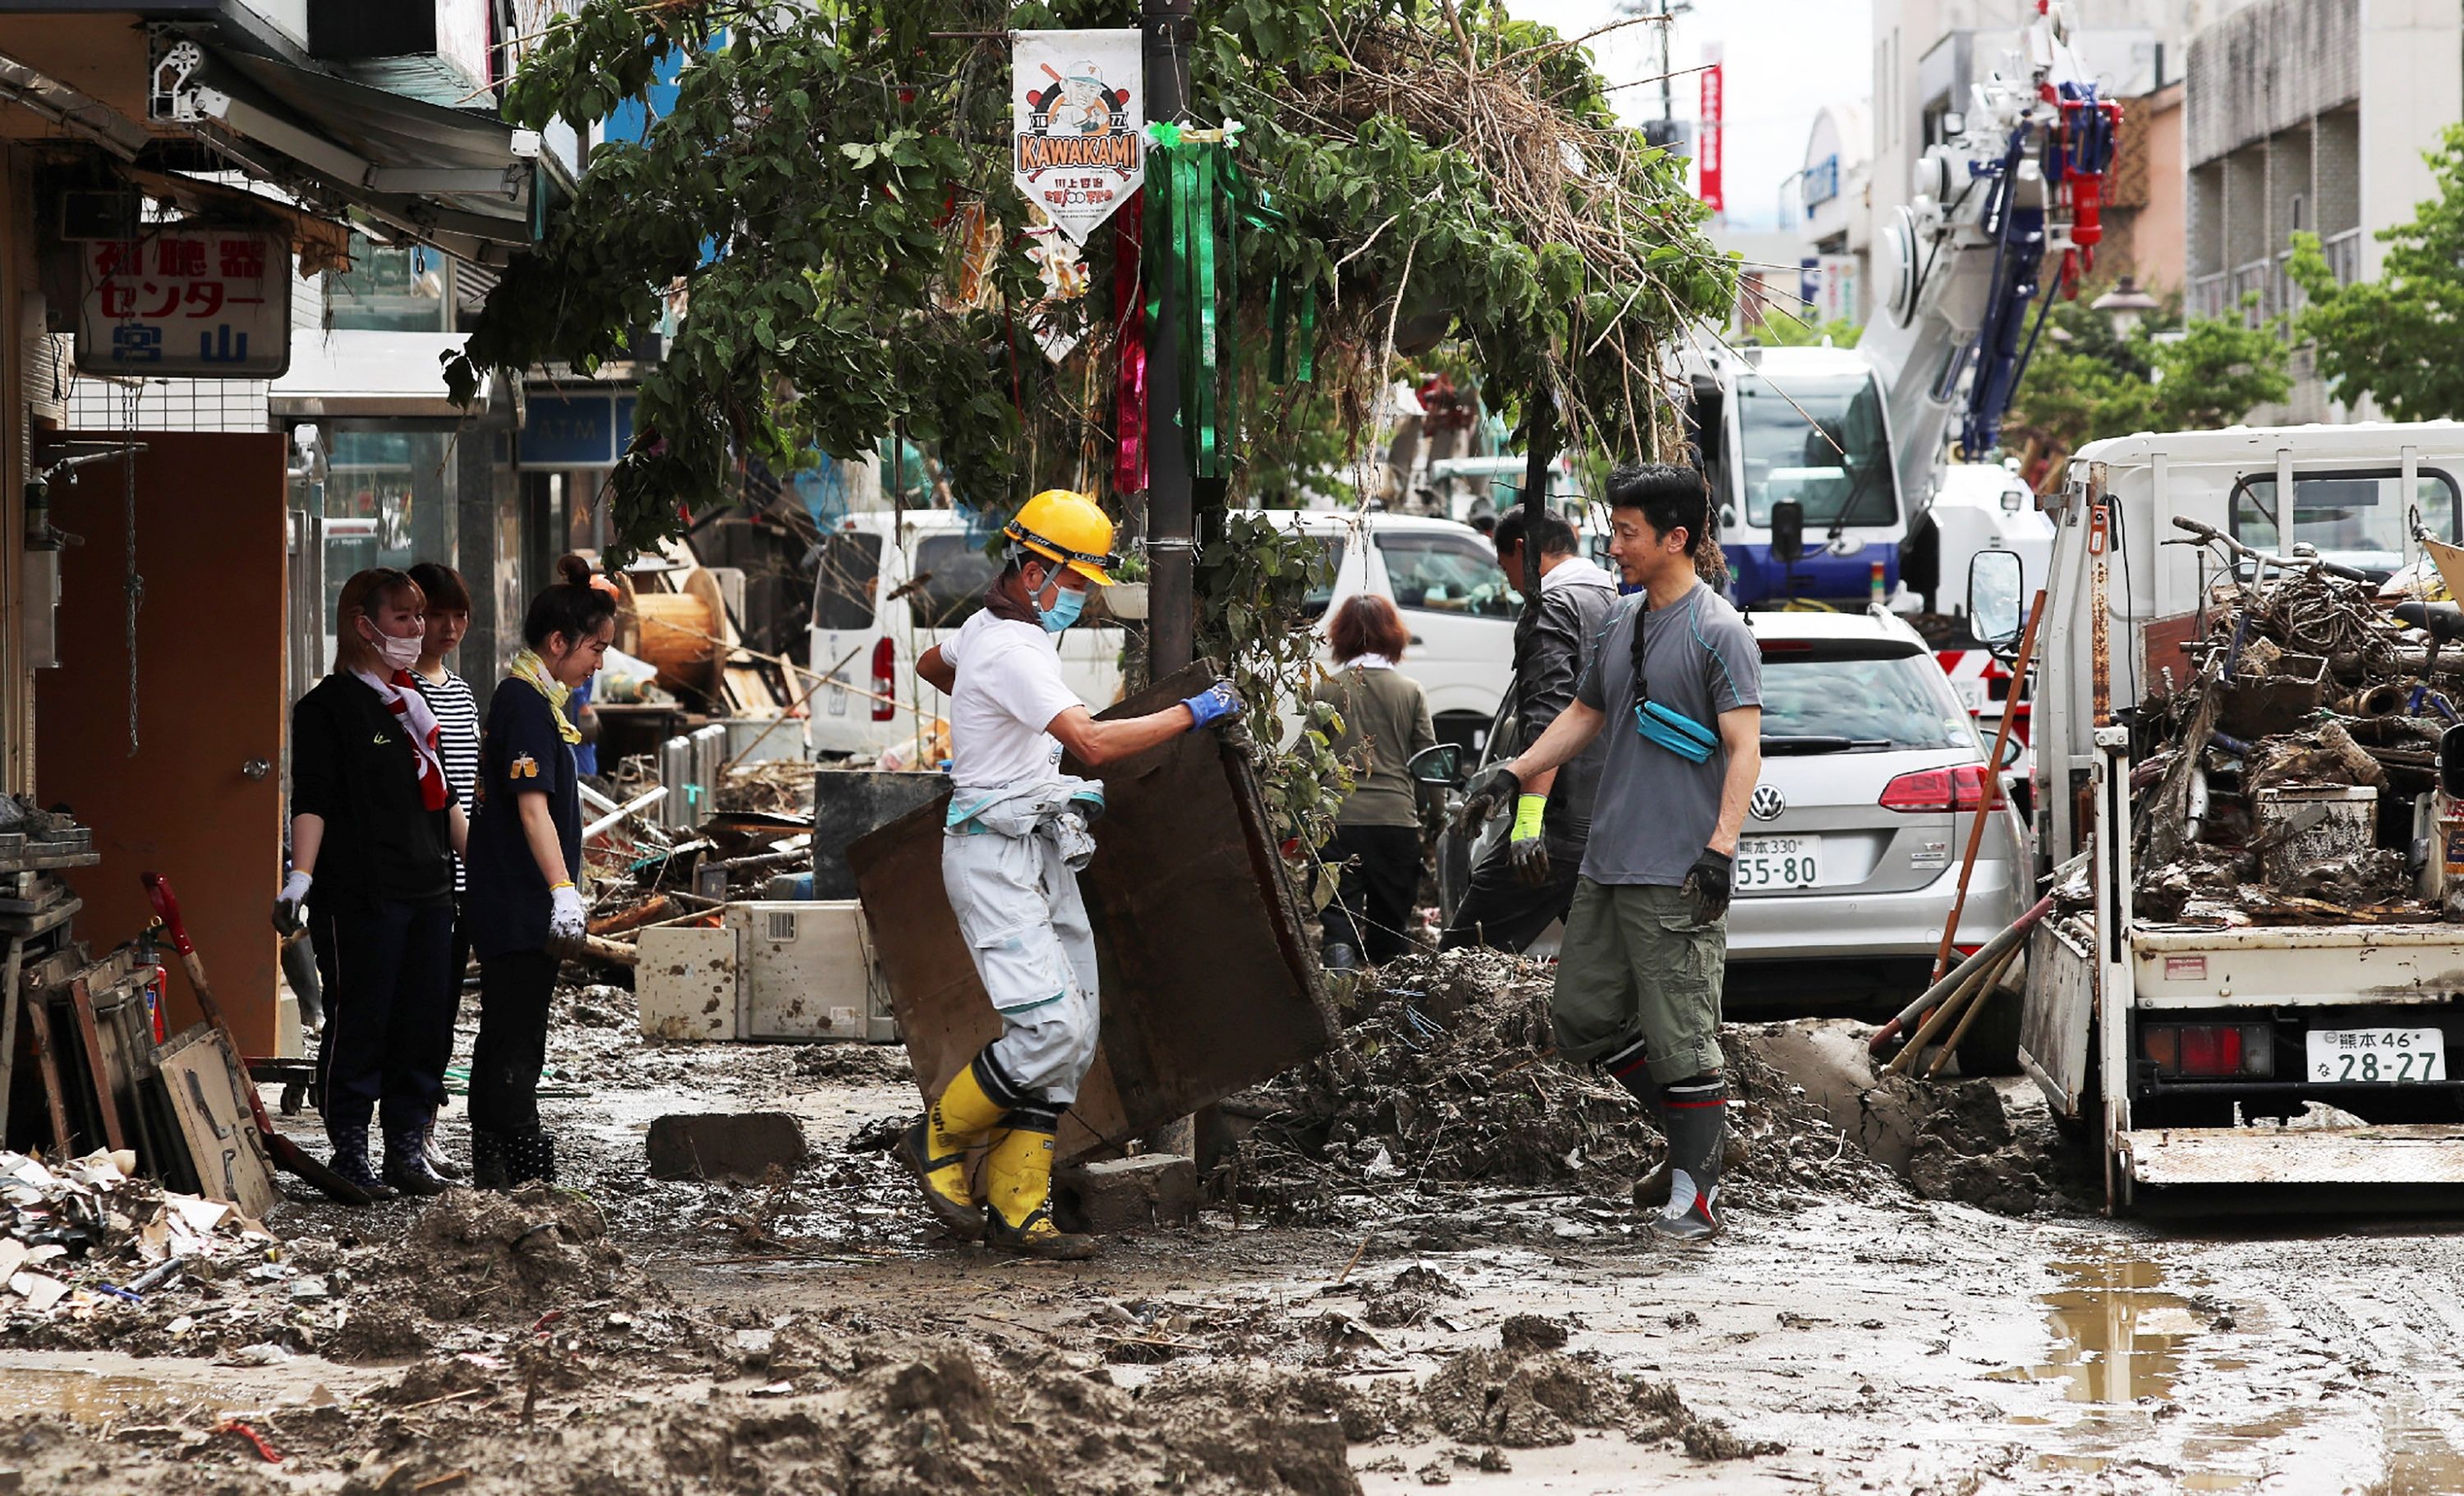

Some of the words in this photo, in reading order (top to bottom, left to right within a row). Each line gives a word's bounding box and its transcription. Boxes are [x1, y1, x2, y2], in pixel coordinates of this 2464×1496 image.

[1036, 116, 1047, 126] 16
[1110, 115, 1123, 126] 77
[1019, 133, 1138, 171] KAWAKAMI
[95, 279, 265, 319] センター
[538, 419, 596, 440] ATM
[1738, 857, 1816, 884] 55-80
[2317, 1062, 2331, 1077] な
[2338, 1052, 2436, 1083] 28-27
